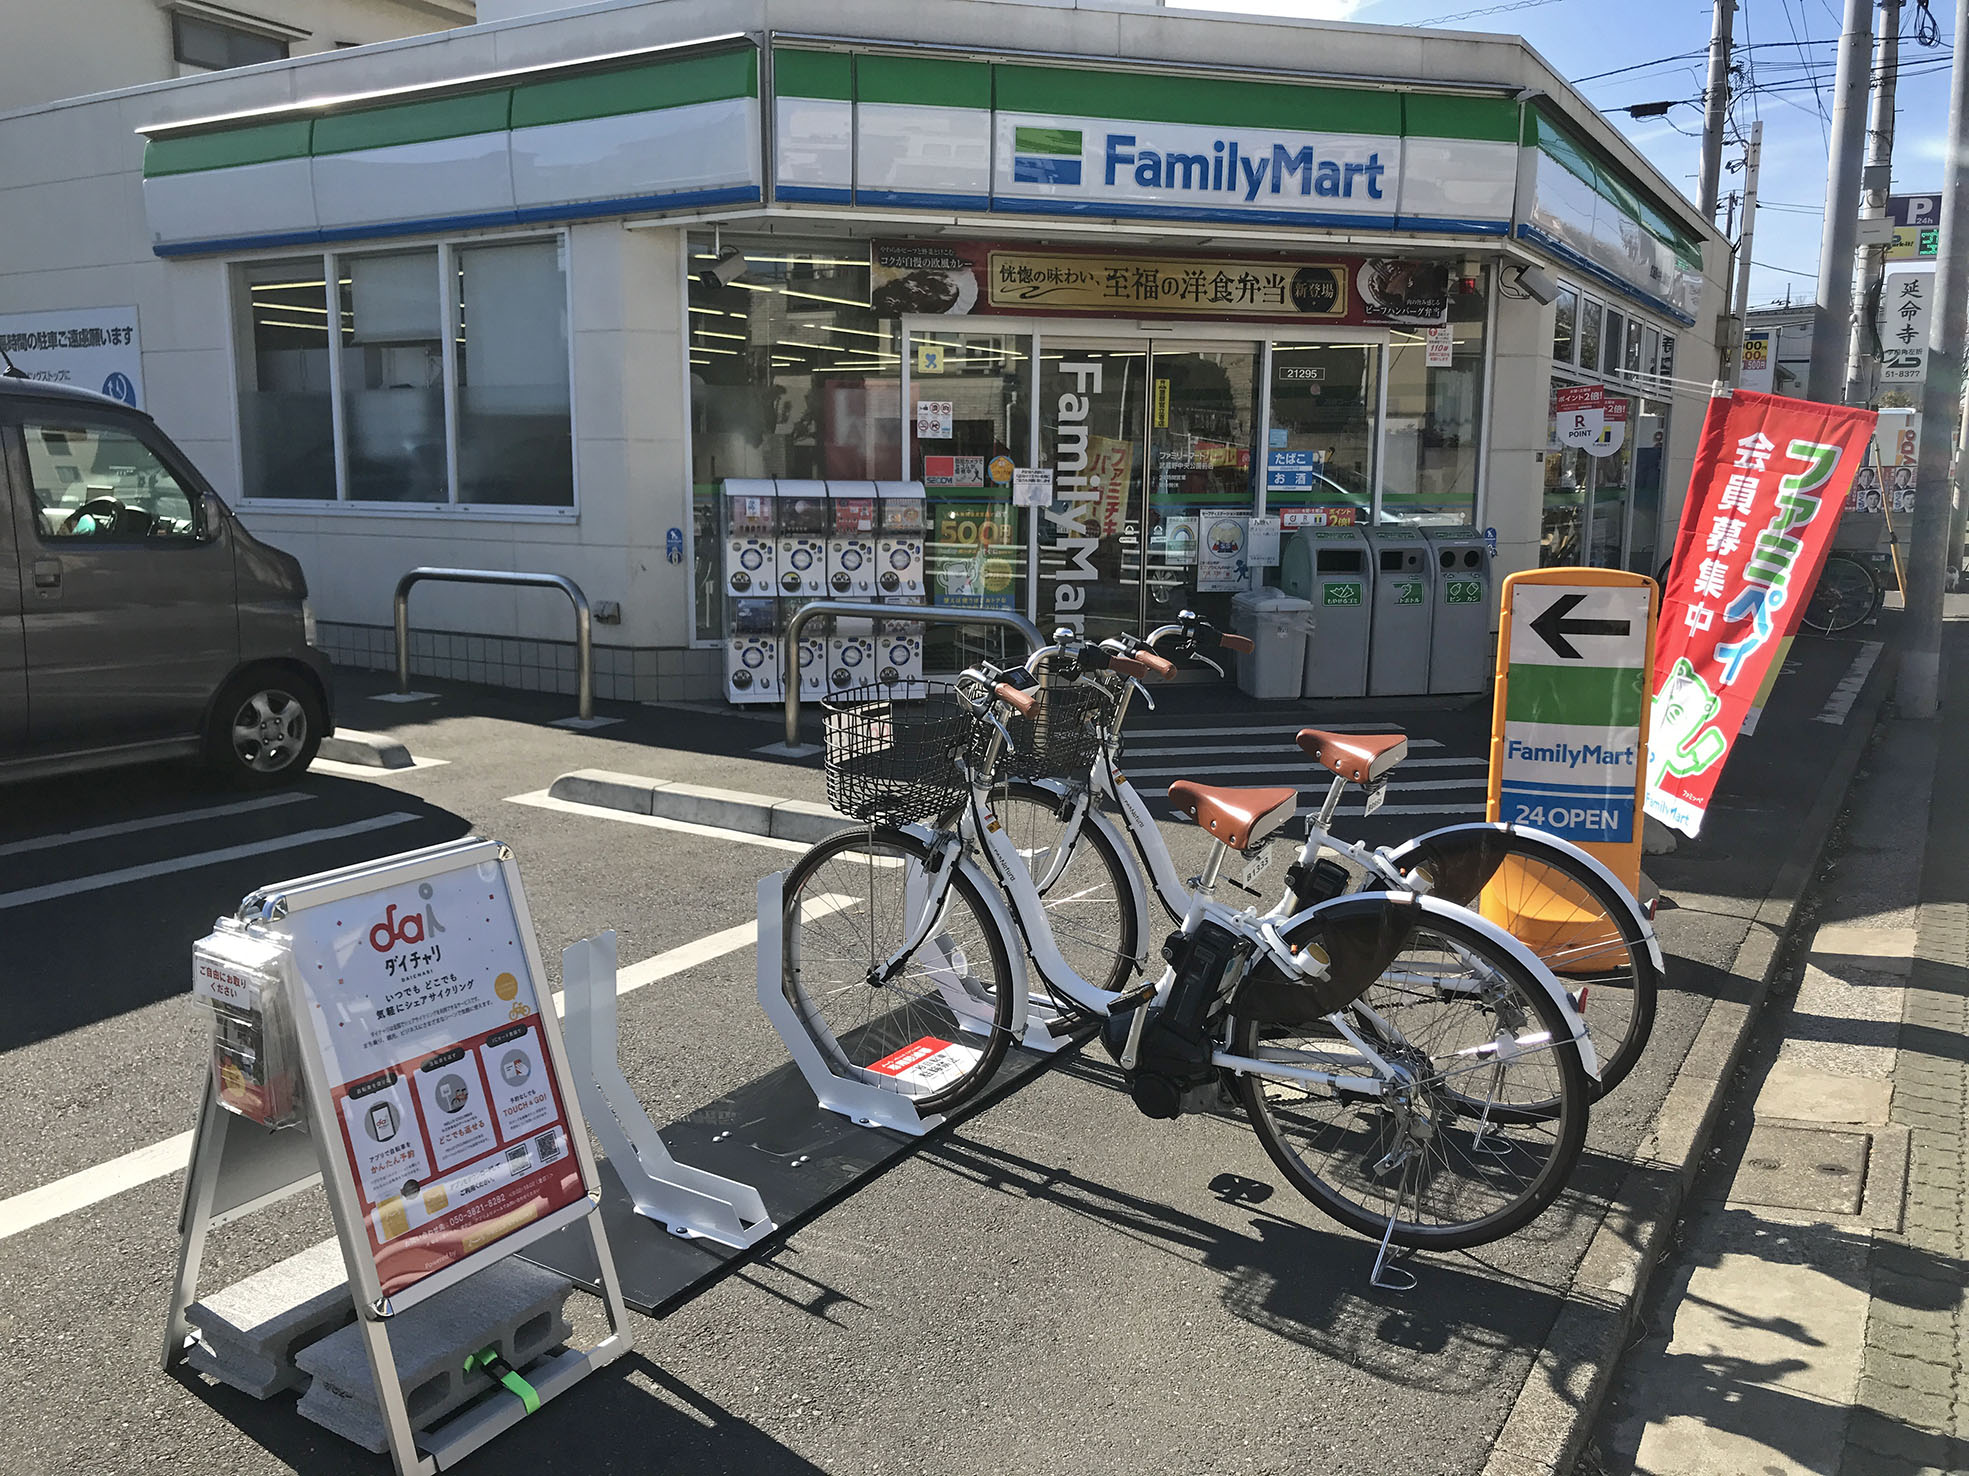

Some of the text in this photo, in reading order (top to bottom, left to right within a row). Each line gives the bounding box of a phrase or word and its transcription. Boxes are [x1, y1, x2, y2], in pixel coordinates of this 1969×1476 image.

[1105, 133, 1385, 201] FamilyMart
[1907, 197, 1933, 224] P
[880, 256, 973, 269] コクが自慢の欧風カレー
[1000, 264, 1287, 305] 恍惚の味わい、 至福の洋食弁当
[1294, 281, 1335, 299] 新登場
[1365, 305, 1440, 318] ビーフハンバーグ弁当
[1896, 279, 1923, 345] 延命寺
[1287, 369, 1318, 379] 21295
[1885, 370, 1921, 378] 51-8377
[1558, 391, 1603, 403] ポイント2倍!
[1568, 430, 1592, 438] POINT
[1275, 453, 1306, 465] たばこ
[1274, 472, 1306, 485] お酒
[1103, 447, 1126, 537] ファミチキ
[941, 520, 1013, 546] 500円
[1684, 432, 1776, 638] 会員募集中
[1714, 438, 1843, 686] ファミペイ
[1507, 740, 1633, 768] FamilyMart
[1514, 804, 1619, 830] 24 OPEN
[385, 944, 443, 977] ダイチャリ
[199, 965, 247, 989] ご自由にお取り
[210, 982, 238, 998] ください
[385, 973, 457, 1002] いつでも どこでも
[376, 979, 475, 1020] 気軽にシェアサイクリング
[502, 1100, 528, 1117] TOUCH
[533, 1092, 547, 1104] GO!
[509, 1088, 536, 1104] 予約なしでも
[438, 1118, 485, 1145] どこでも返せる
[368, 1140, 411, 1163] アプリで自転車を
[369, 1148, 415, 1175] かんたん予約
[448, 1192, 505, 1227] 050-3821-8282
[424, 1252, 447, 1270] Powered
